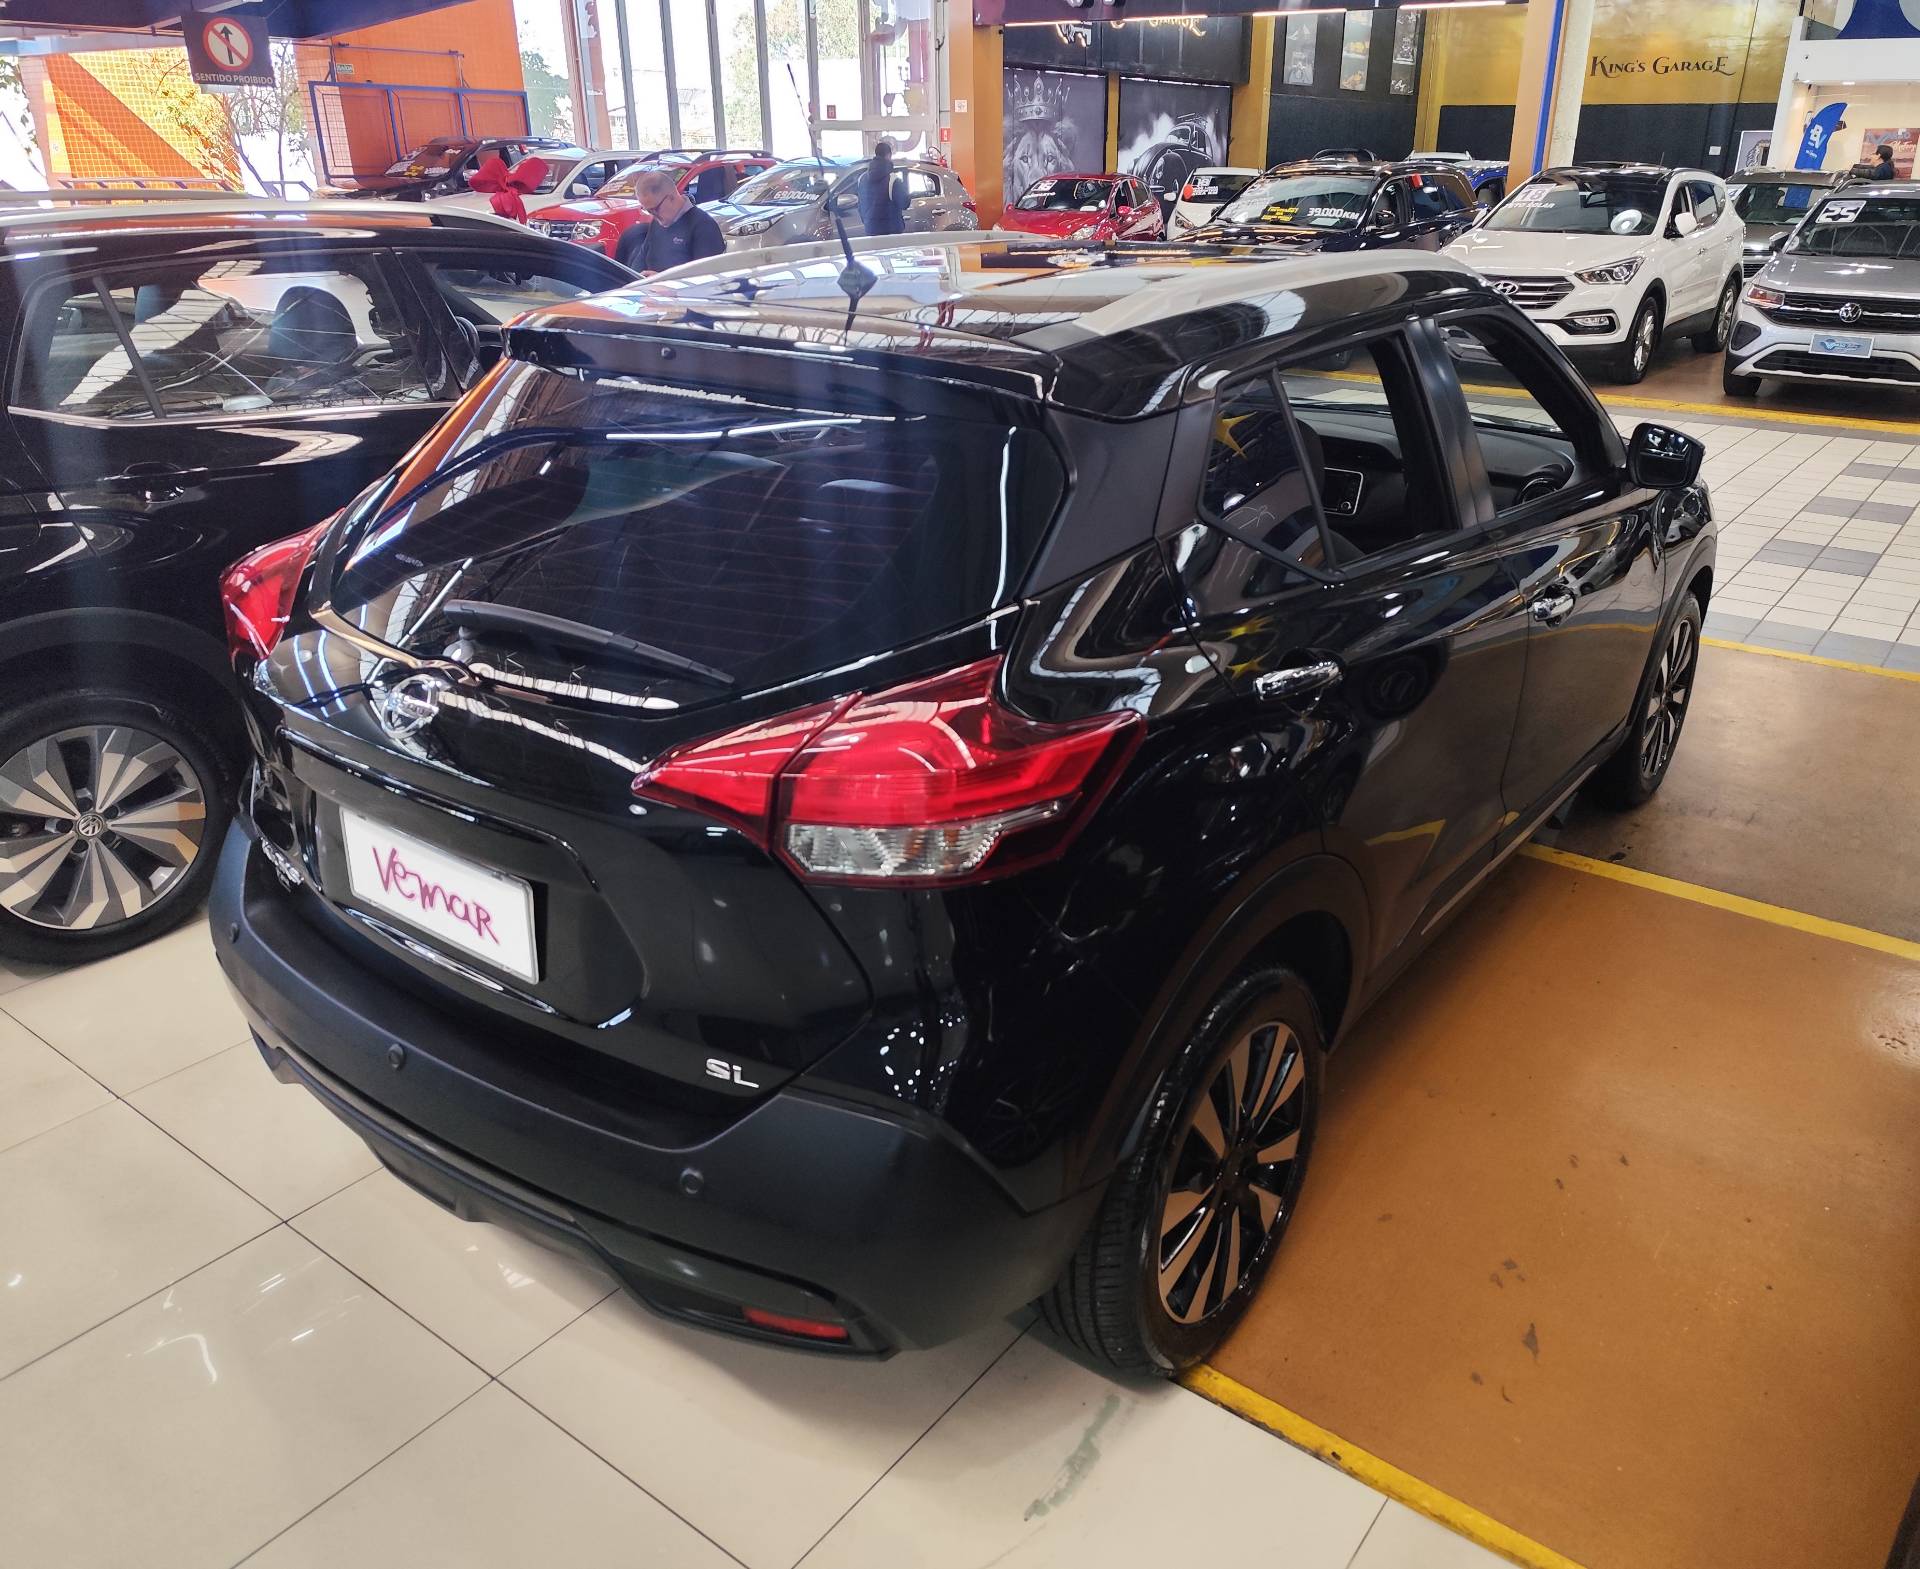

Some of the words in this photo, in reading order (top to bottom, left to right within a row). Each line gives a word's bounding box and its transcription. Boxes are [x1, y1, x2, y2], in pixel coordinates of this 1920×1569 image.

[195, 72, 232, 83] SENTIDO
[233, 74, 274, 85] PROIBIDO
[1819, 206, 1858, 222] 25
[705, 1058, 760, 1089] SL
